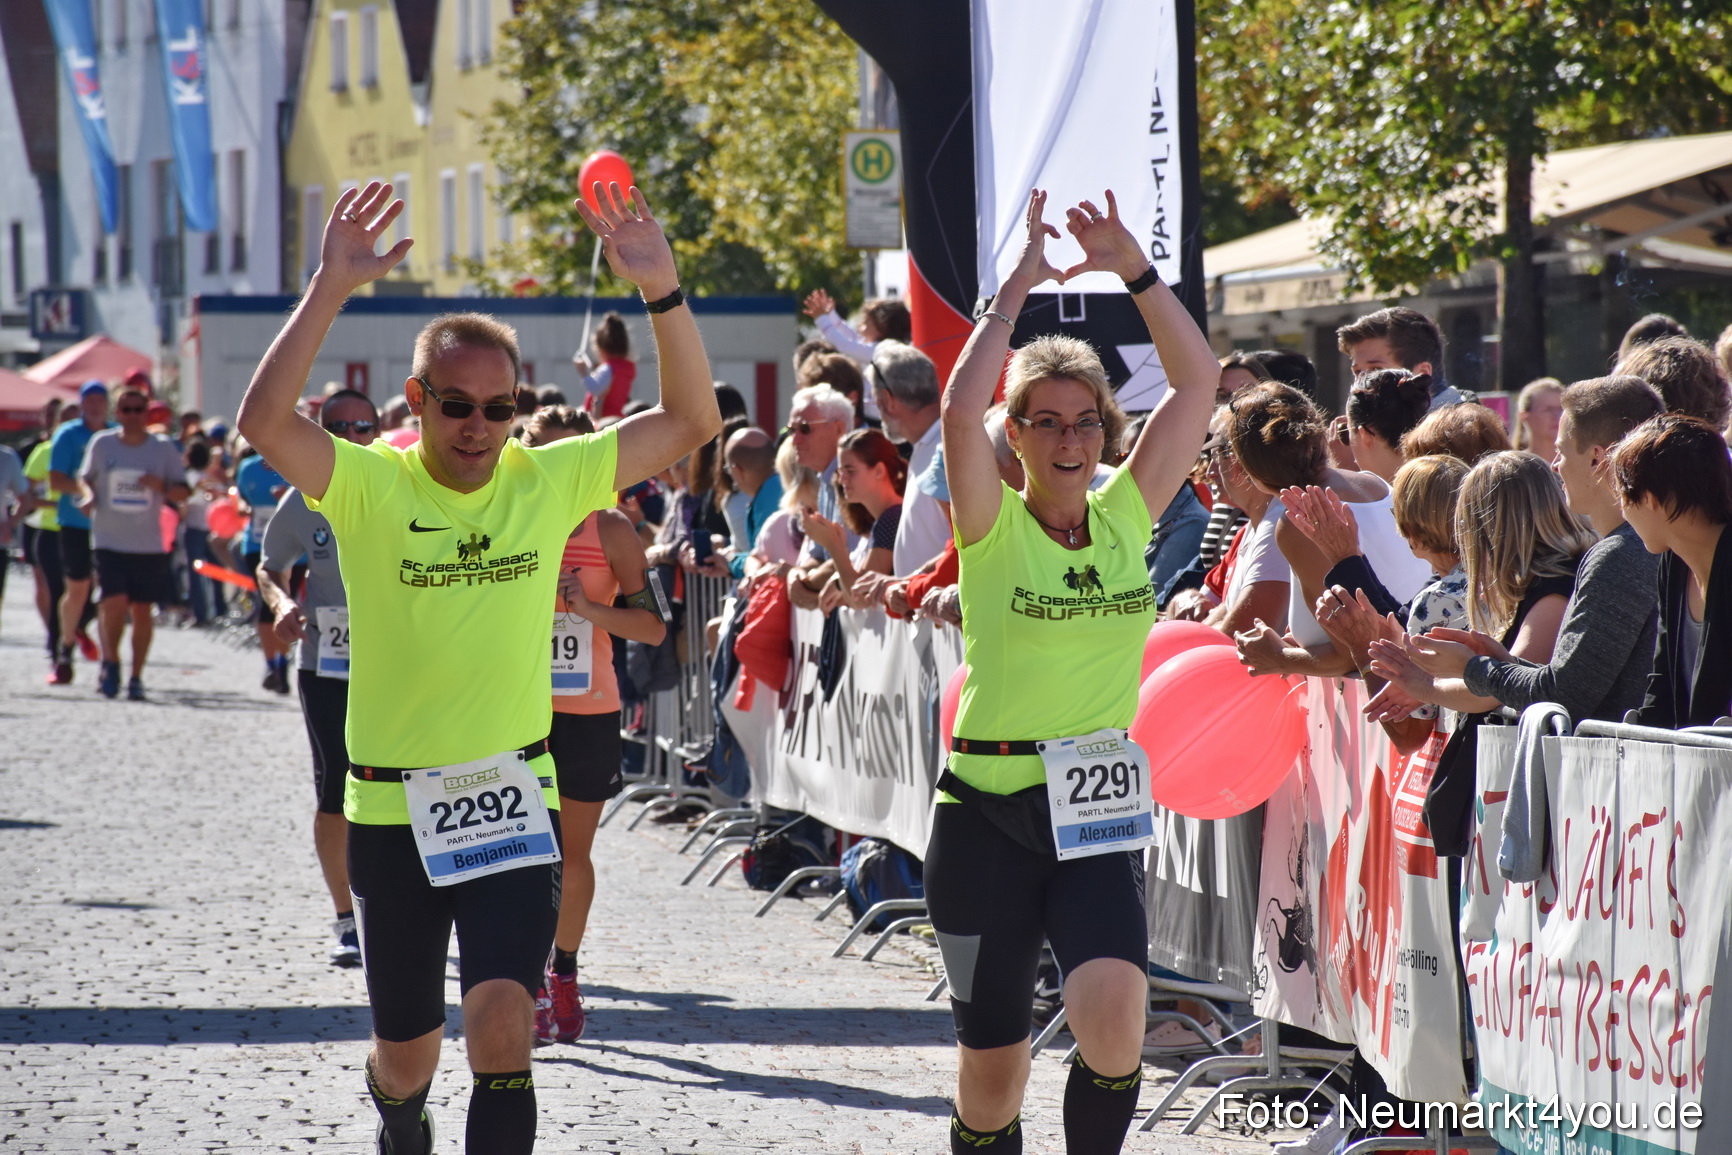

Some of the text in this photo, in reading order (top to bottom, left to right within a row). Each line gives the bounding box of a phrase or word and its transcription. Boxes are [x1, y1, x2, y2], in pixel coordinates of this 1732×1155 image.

[401, 559, 424, 573] SC
[1014, 586, 1035, 602] SC
[1077, 738, 1125, 756] BOC
[444, 767, 501, 790] BOCK
[1066, 761, 1140, 805] 2291
[429, 786, 529, 835] 2292
[1078, 808, 1103, 818] PARTL
[422, 830, 428, 838] B
[446, 826, 515, 846] PARTL Neumarkt
[453, 840, 529, 870] Benjamin
